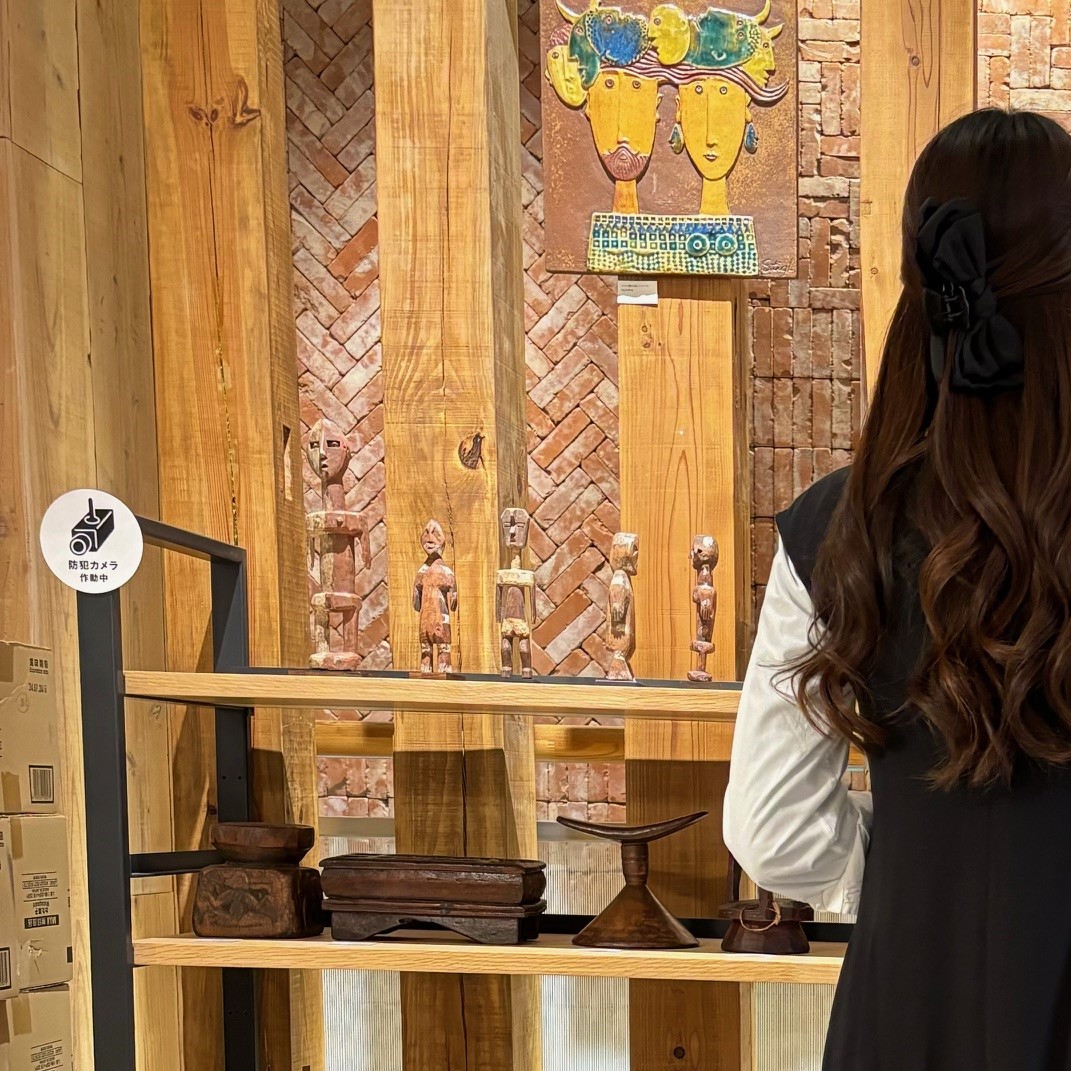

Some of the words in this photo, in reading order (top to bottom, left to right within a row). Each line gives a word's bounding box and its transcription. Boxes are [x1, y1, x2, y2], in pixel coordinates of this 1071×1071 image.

[68, 560, 119, 571] 防犯カメラ
[79, 573, 109, 583] 作動中
